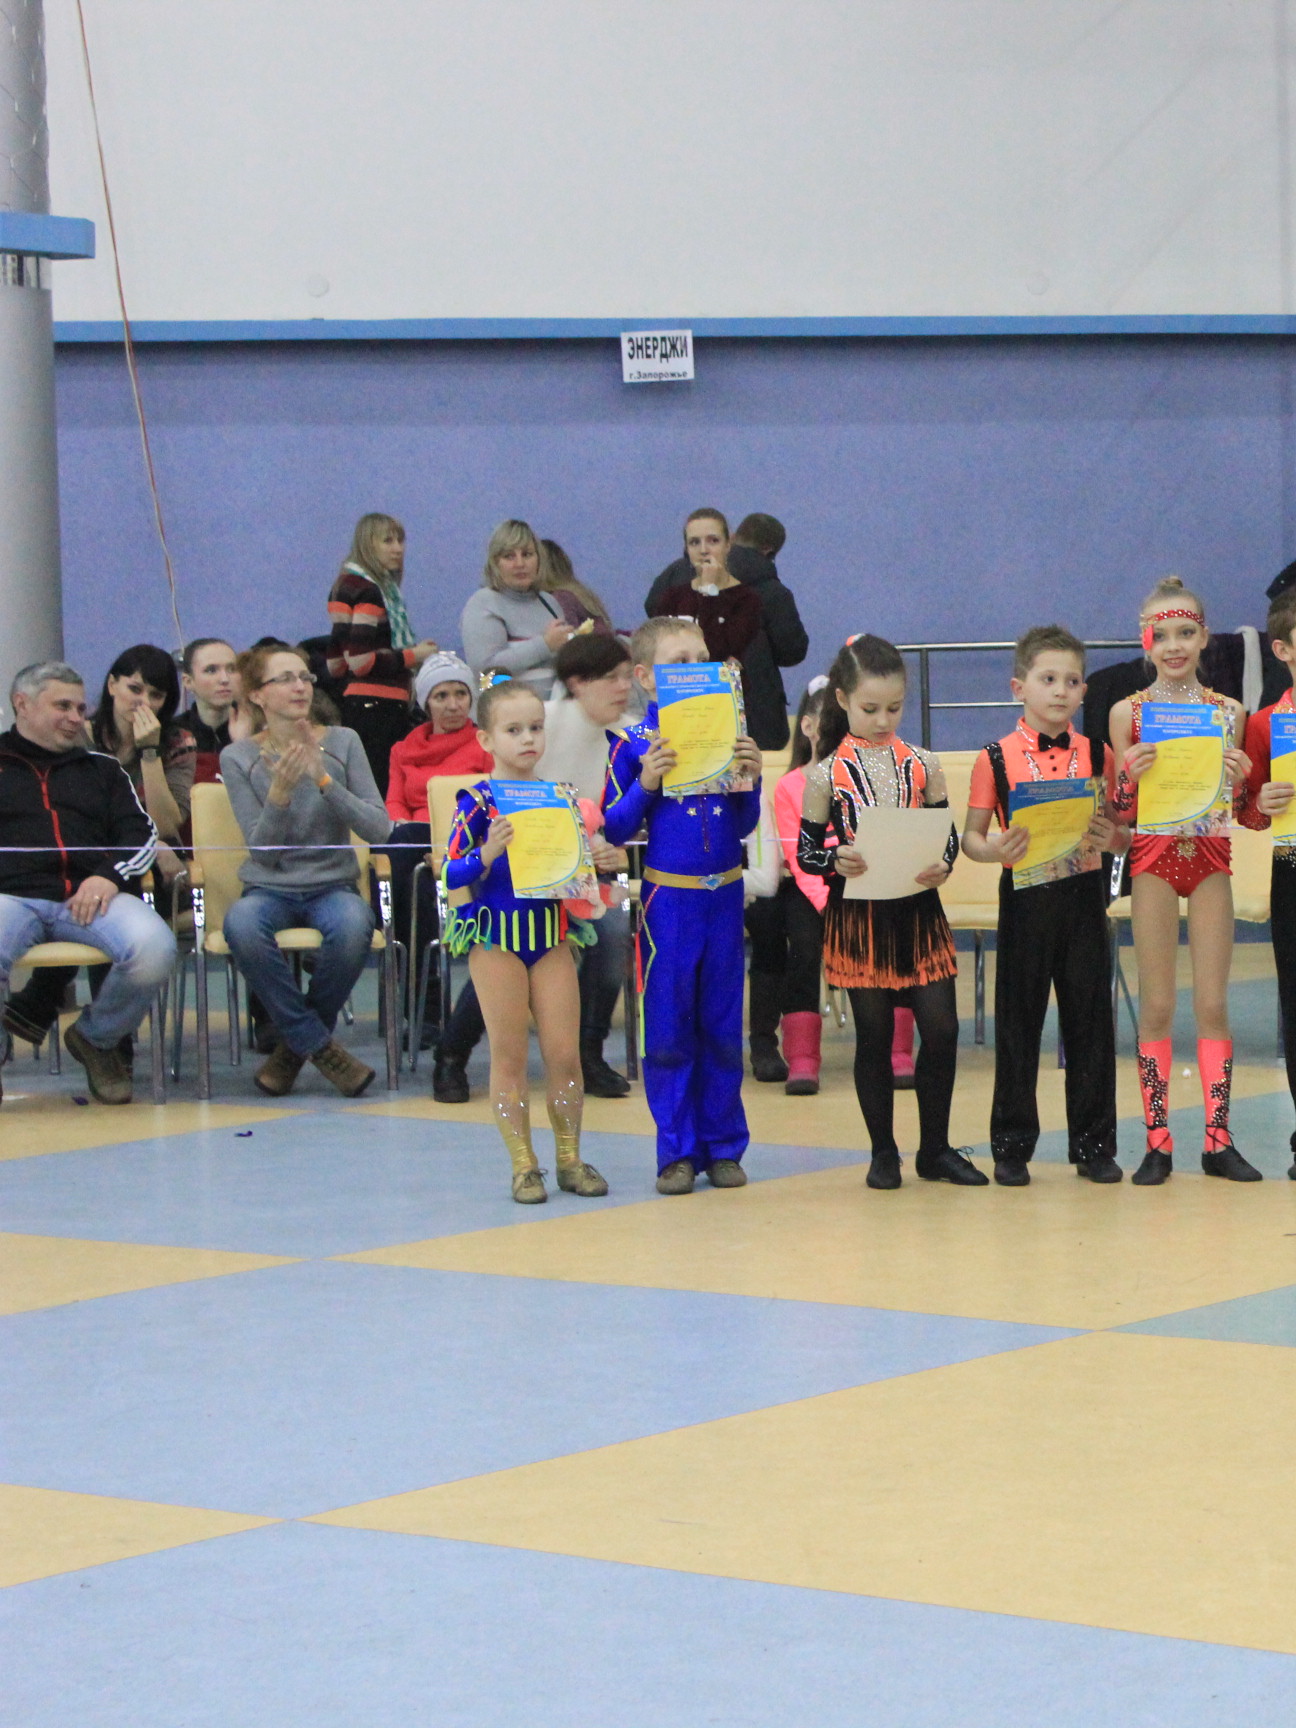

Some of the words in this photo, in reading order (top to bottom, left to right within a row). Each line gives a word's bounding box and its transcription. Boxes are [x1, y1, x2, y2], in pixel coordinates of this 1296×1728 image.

[628, 336, 688, 363] ЭНЕРДЖИ
[629, 370, 688, 381] г.Запорожье
[667, 674, 711, 684] ГРАМОТА
[1155, 714, 1201, 724] ГРАМОТА
